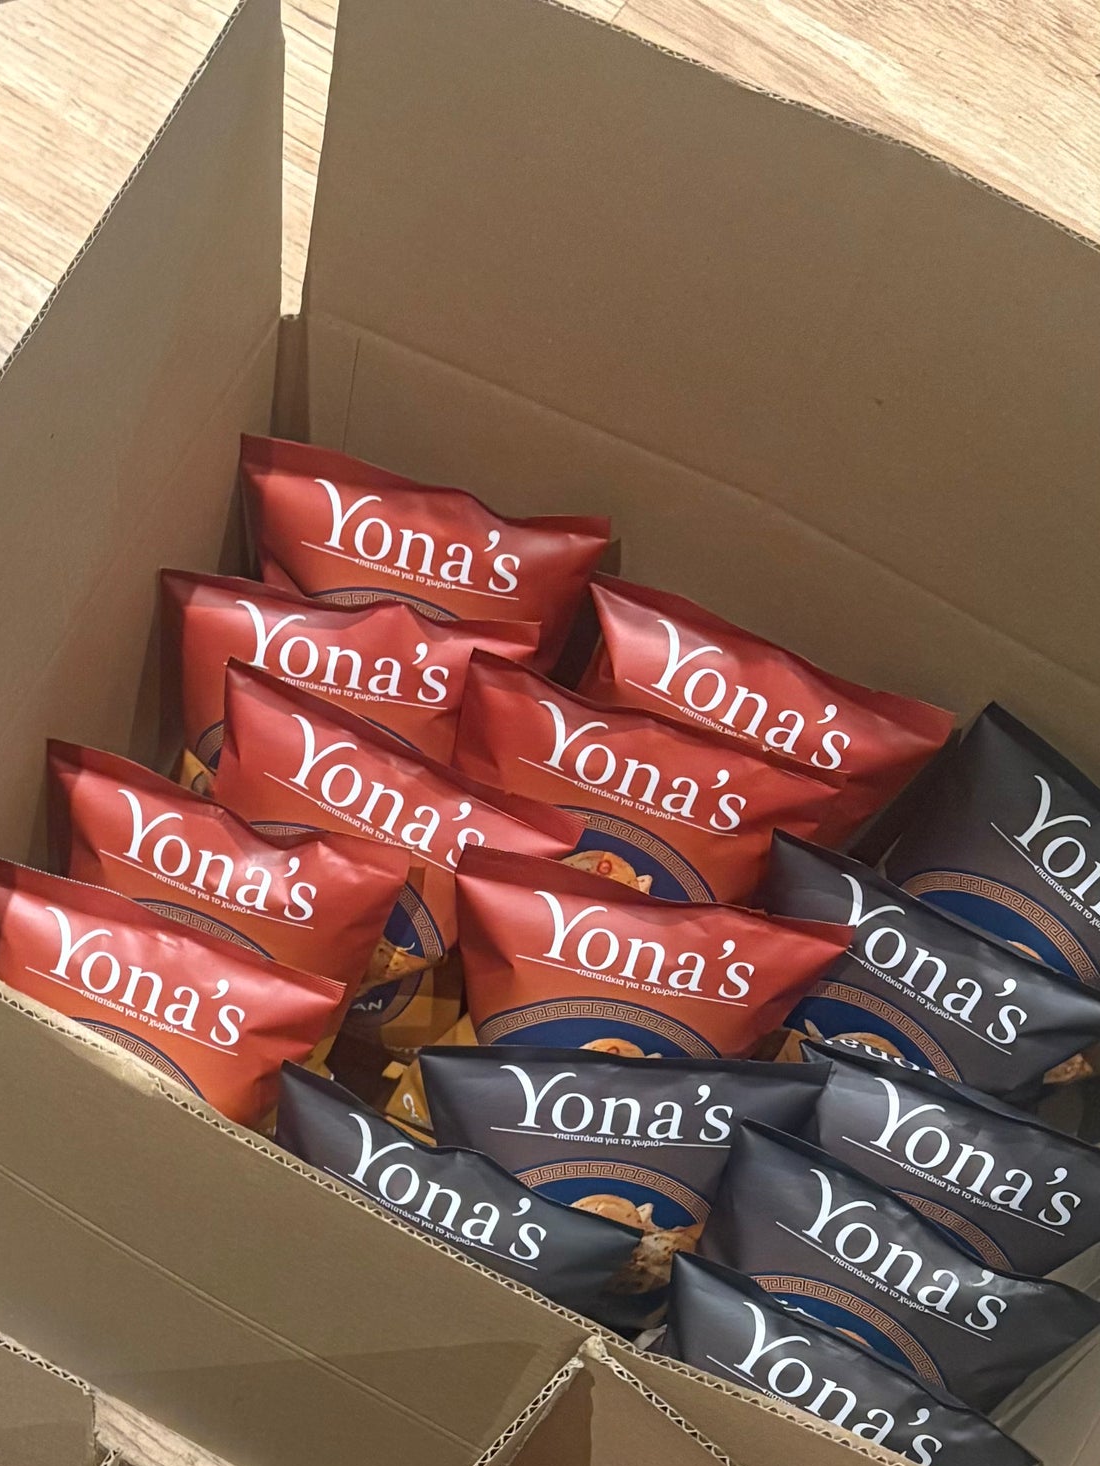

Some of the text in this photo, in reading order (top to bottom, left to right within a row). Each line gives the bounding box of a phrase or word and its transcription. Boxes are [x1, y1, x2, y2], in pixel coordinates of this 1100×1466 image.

[314, 479, 520, 592] Yona's
[232, 600, 449, 703] Yona's
[642, 619, 851, 769] Yona's
[539, 700, 746, 830] Yona's
[117, 789, 317, 920] Yona's
[46, 906, 246, 1046] Yona's
[534, 891, 754, 998] Yona's
[847, 877, 1027, 1044] Yona's
[500, 1065, 733, 1142] Yona's
[870, 1077, 1080, 1225] Yona's
[348, 1113, 547, 1260] Yona's
[802, 1169, 1006, 1330] Yona's
